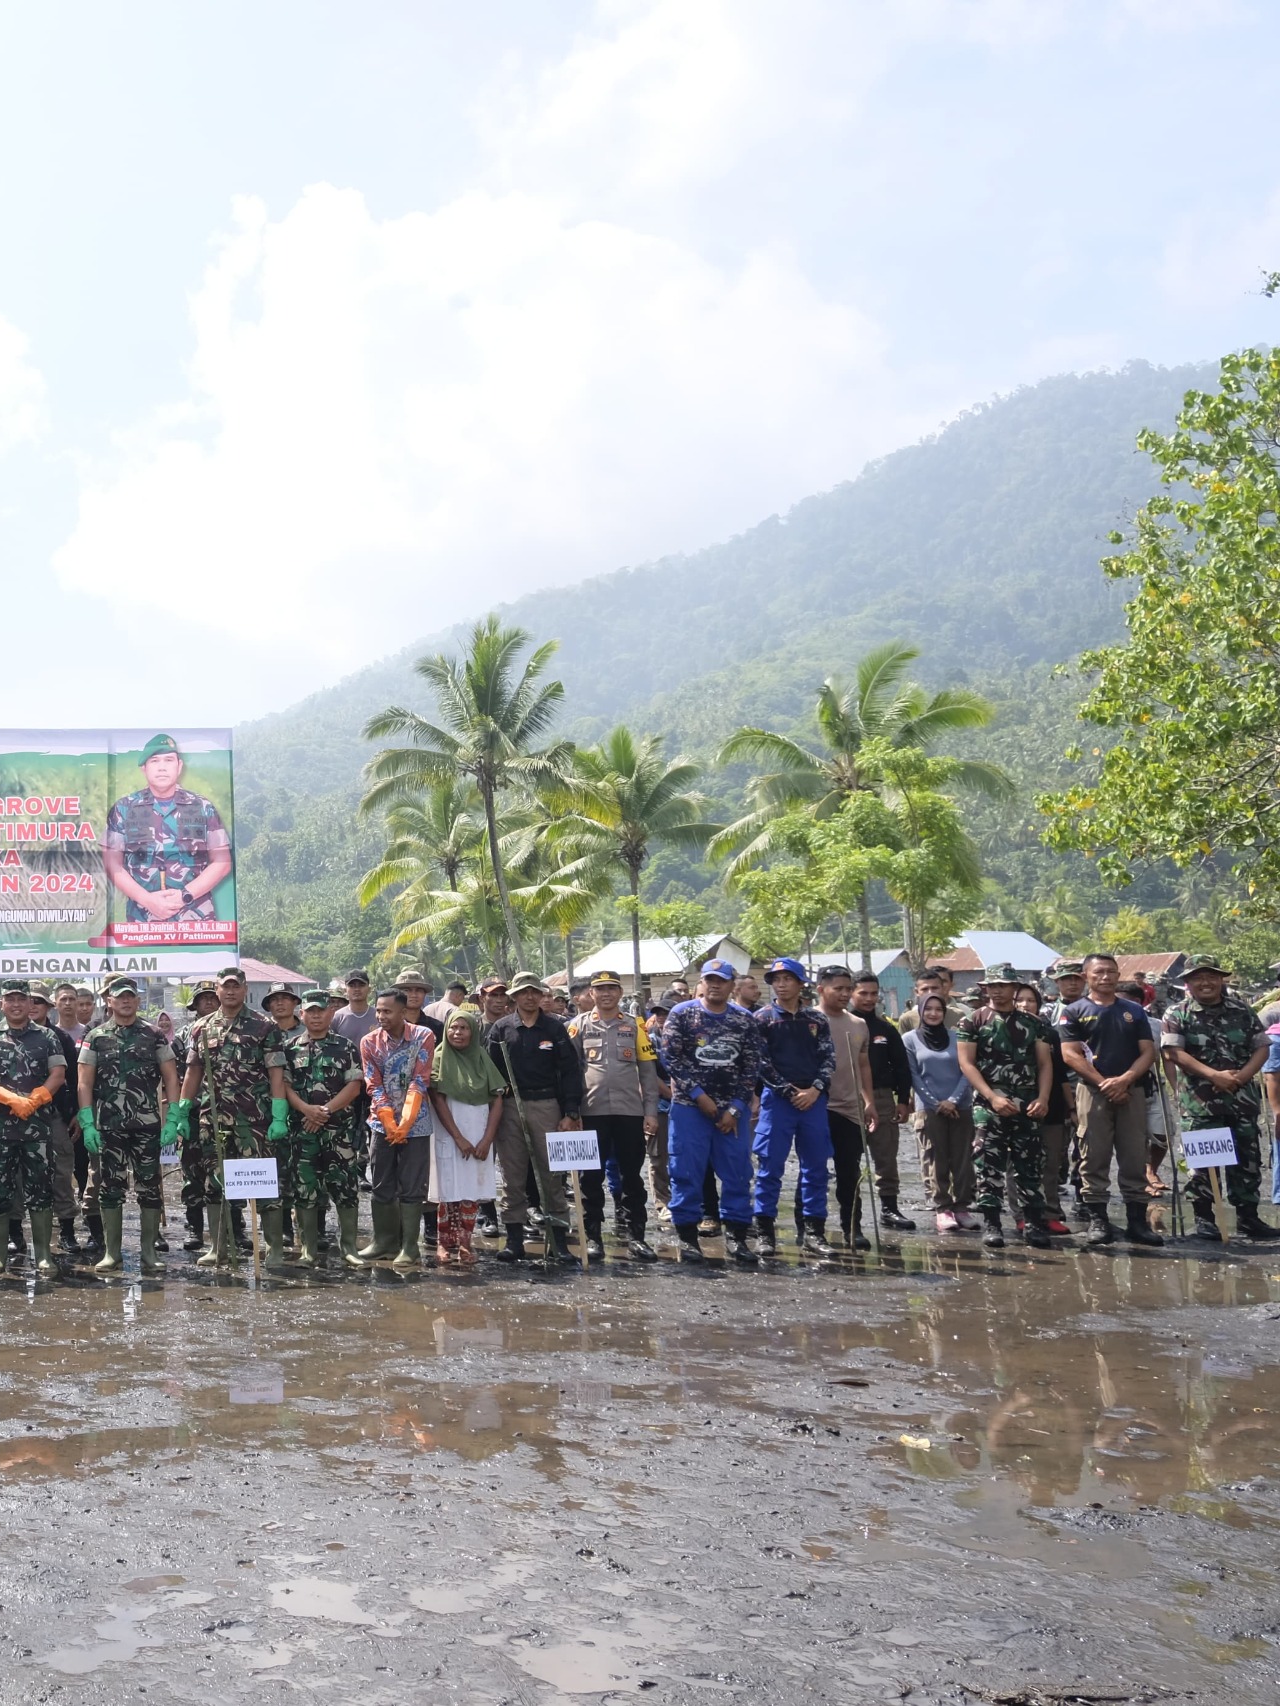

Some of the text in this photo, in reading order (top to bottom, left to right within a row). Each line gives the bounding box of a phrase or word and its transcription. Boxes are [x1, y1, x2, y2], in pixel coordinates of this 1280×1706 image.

[29, 874, 94, 893] 2024
[37, 909, 87, 922] DIWILAYAH
[123, 934, 161, 942] Pangdam
[2, 958, 90, 973] DENGAN
[99, 957, 157, 972] ALAM
[1184, 1139, 1233, 1157] KA BEKANG
